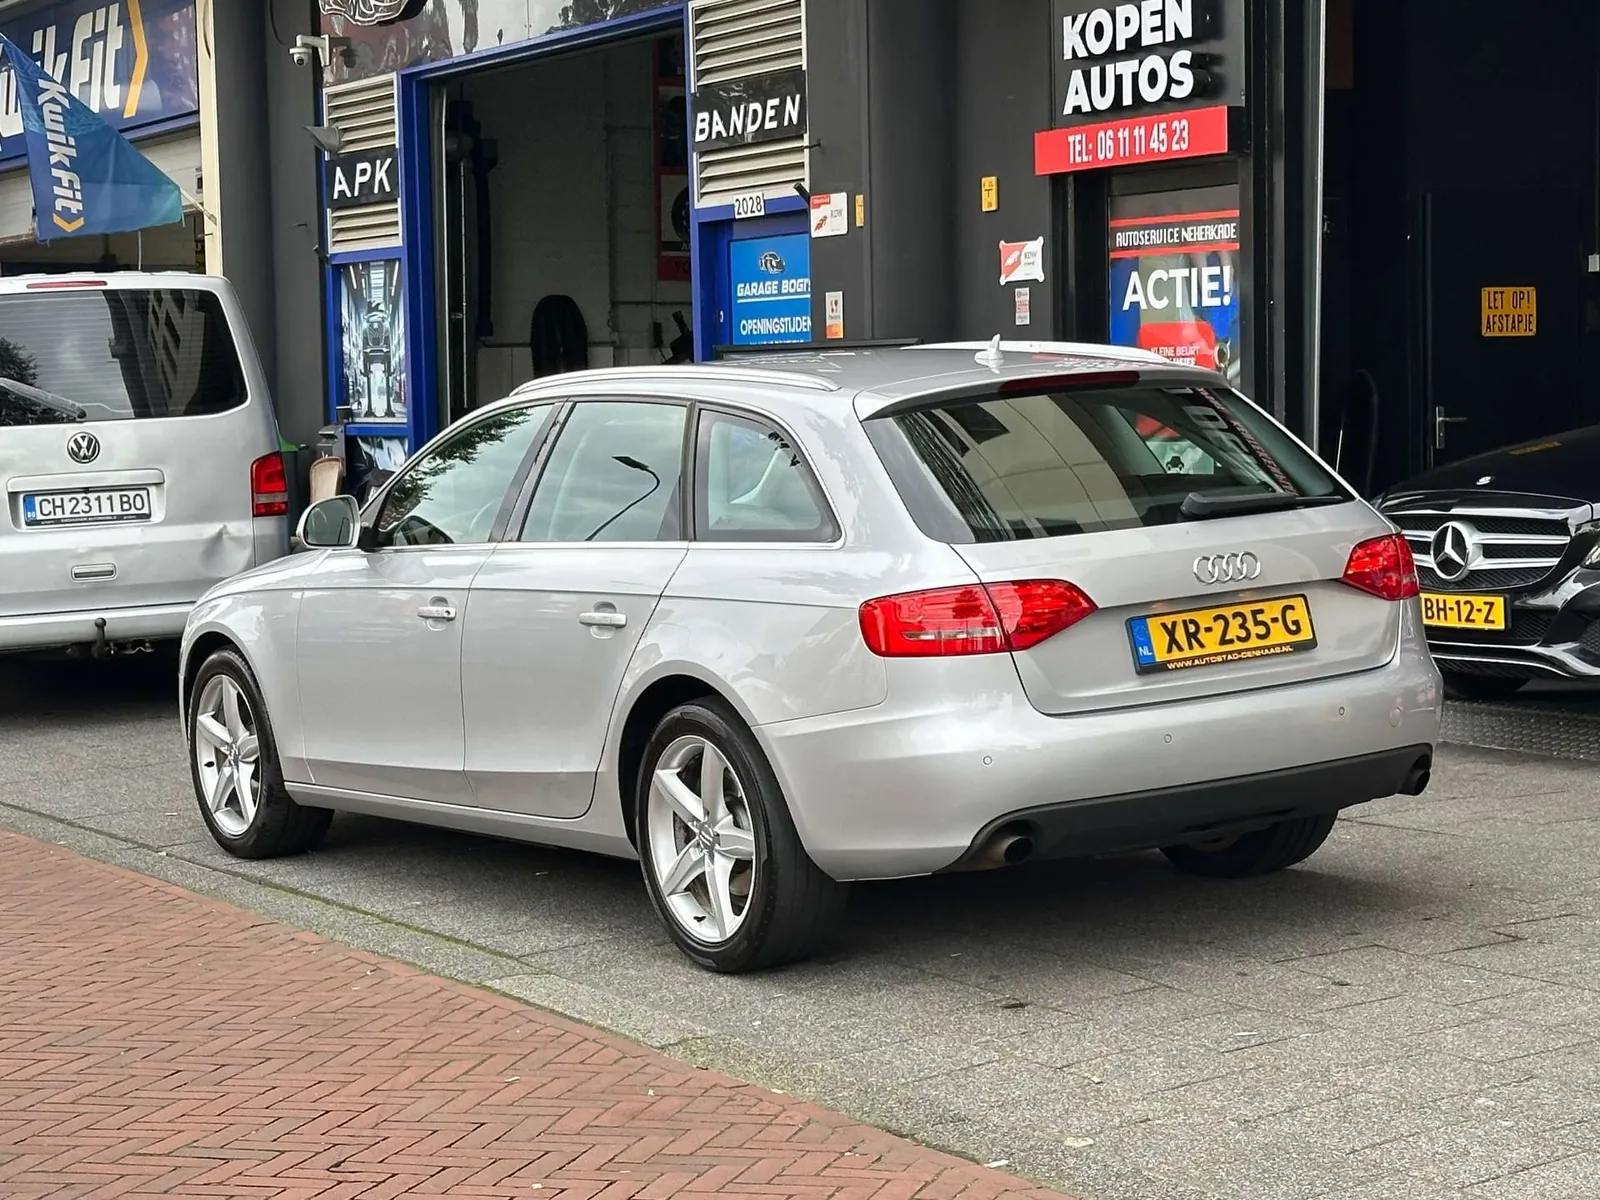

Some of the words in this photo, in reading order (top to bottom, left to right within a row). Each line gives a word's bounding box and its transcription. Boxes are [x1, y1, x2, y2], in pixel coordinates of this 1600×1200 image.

[1063, 0, 1193, 60] KOPEN
[1063, 49, 1195, 116] AUTOS
[694, 94, 801, 142] BANDEN
[1067, 133, 1093, 164] TEL:
[1097, 129, 1115, 161] 06
[1117, 127, 1130, 158] 11
[1133, 124, 1146, 156] 11
[1149, 121, 1168, 153] 45
[1171, 118, 1189, 151] 23
[333, 157, 393, 200] APK
[735, 195, 763, 216] 2028
[1181, 222, 1238, 243] NEHERKADE
[737, 280, 779, 297] GARAGE
[1122, 265, 1231, 311] ACTIE!
[1487, 290, 1505, 310] LET
[1511, 290, 1531, 310] OP!
[1485, 314, 1534, 333] AFSTAPJE
[1424, 597, 1496, 625] BH-12-Z
[1159, 604, 1302, 655] XR-235-G
[1138, 645, 1153, 656] NL
